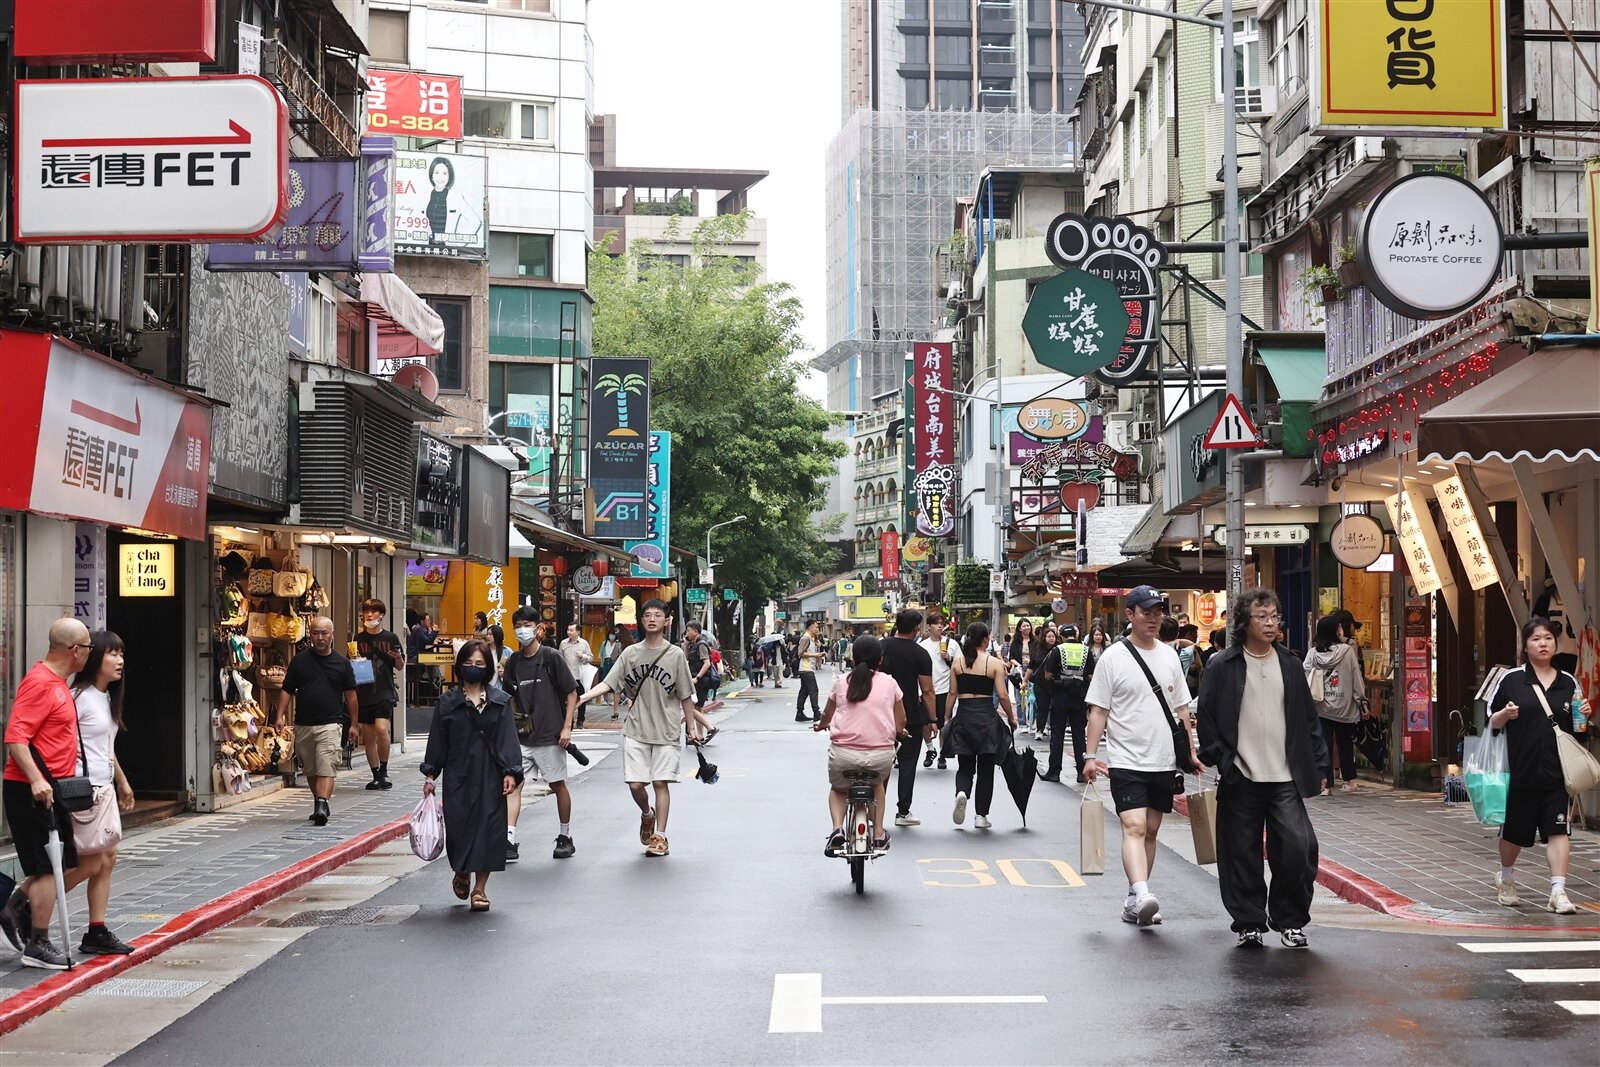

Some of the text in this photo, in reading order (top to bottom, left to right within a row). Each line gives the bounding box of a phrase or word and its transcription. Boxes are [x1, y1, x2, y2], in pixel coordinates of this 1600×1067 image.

[419, 79, 449, 115] 洽
[42, 151, 251, 188] 遠傳 FET
[255, 250, 307, 261] 請上二樓
[1388, 254, 1482, 264] PROTASTE COFFEE
[508, 414, 549, 427] 5571-55
[594, 440, 645, 450] AZÚCAR
[62, 426, 105, 492] 遠傳
[103, 440, 139, 500] FET
[1444, 483, 1465, 510] 咖啡
[616, 504, 640, 521] B1
[1452, 515, 1476, 527] Coffee
[1400, 526, 1421, 538] Coffee
[137, 549, 160, 561] cha
[138, 576, 166, 590] tang
[624, 664, 676, 695] NAUTICA
[915, 858, 1087, 888] 30
